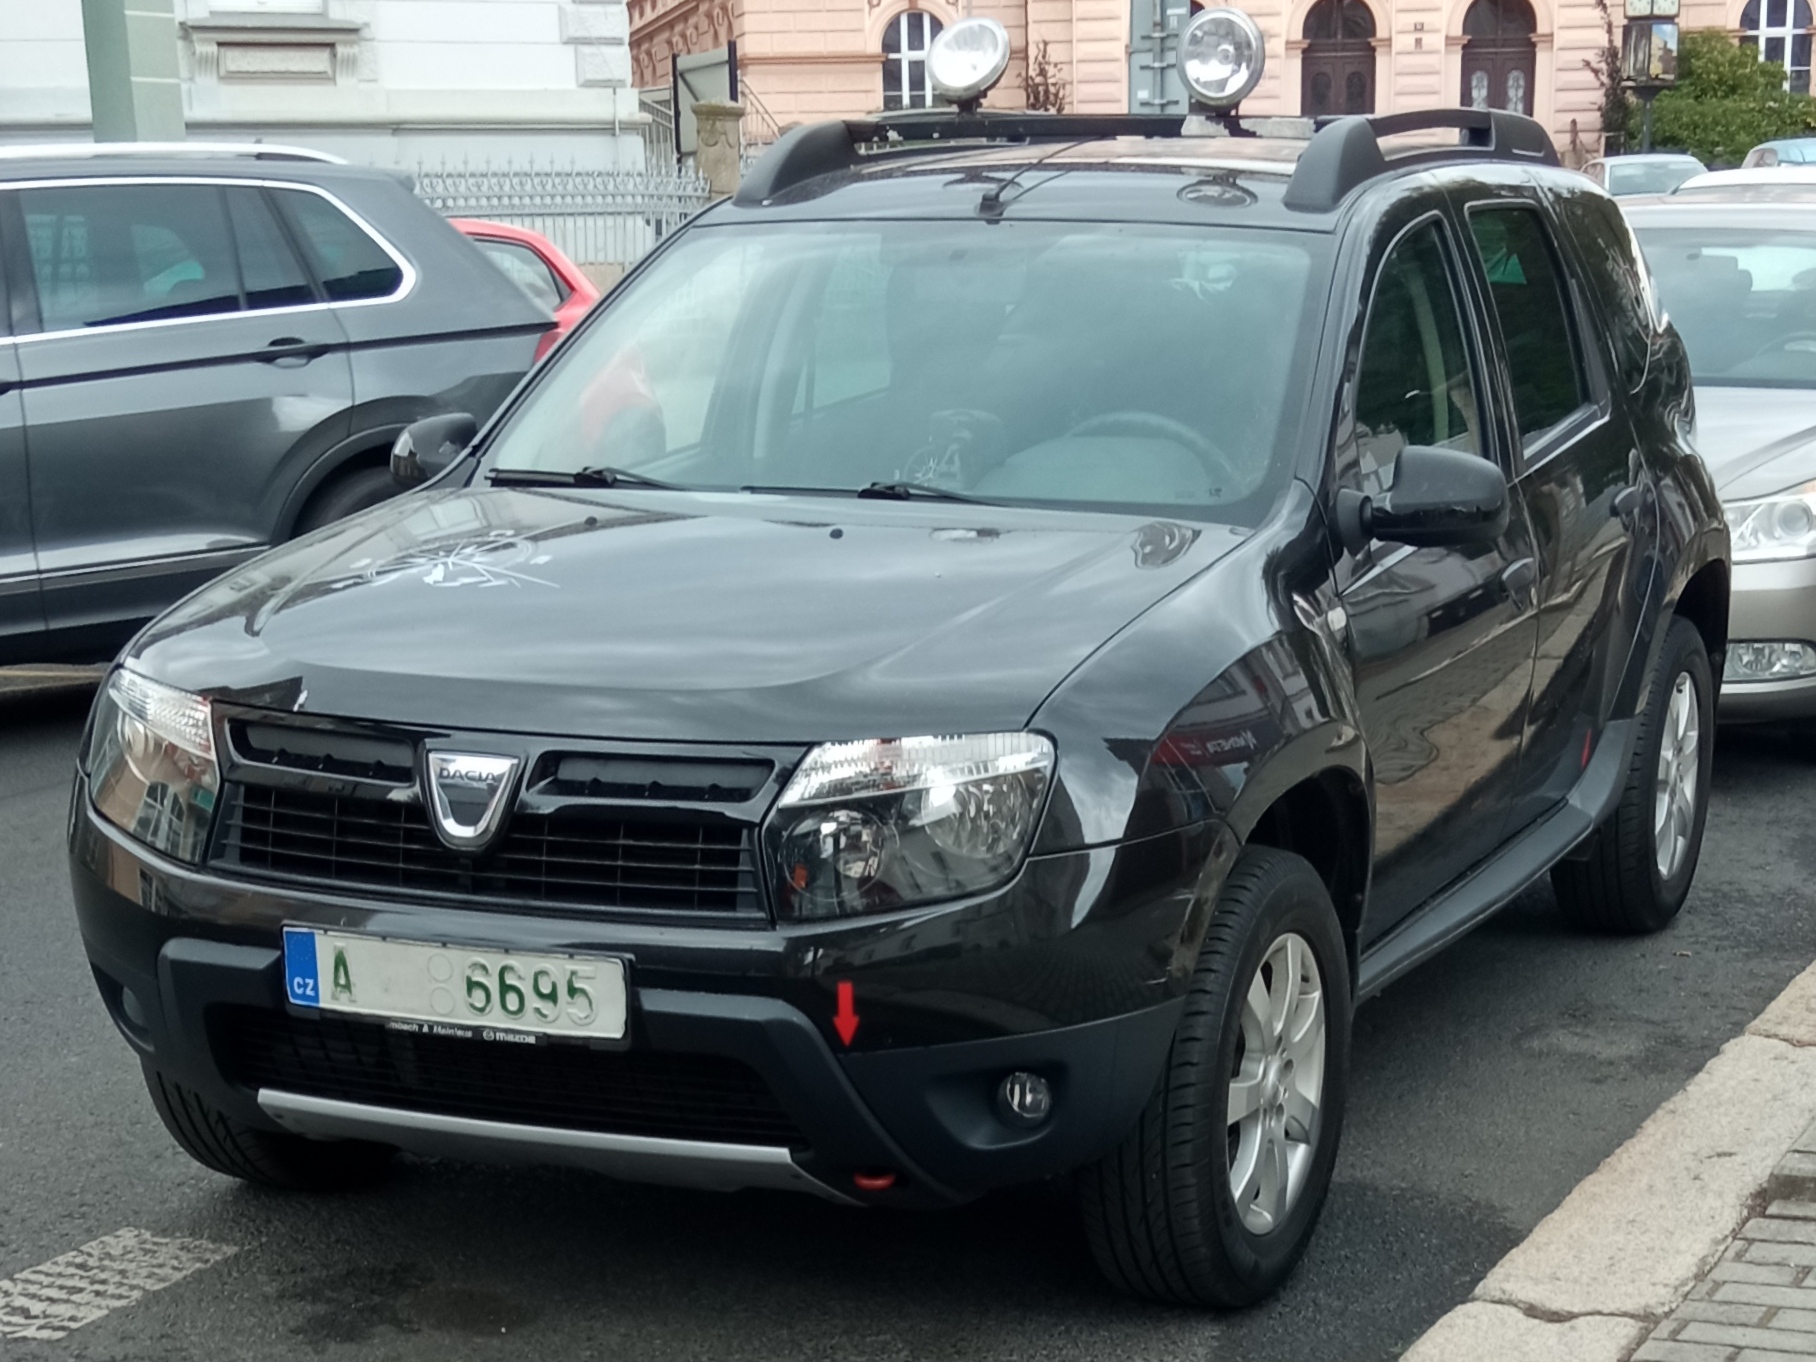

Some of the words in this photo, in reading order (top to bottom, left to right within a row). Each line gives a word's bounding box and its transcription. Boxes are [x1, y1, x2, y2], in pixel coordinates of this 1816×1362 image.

[439, 766, 498, 784] DACIA
[293, 976, 315, 997] CZ
[331, 942, 357, 1003] A
[464, 957, 598, 1026] 6695
